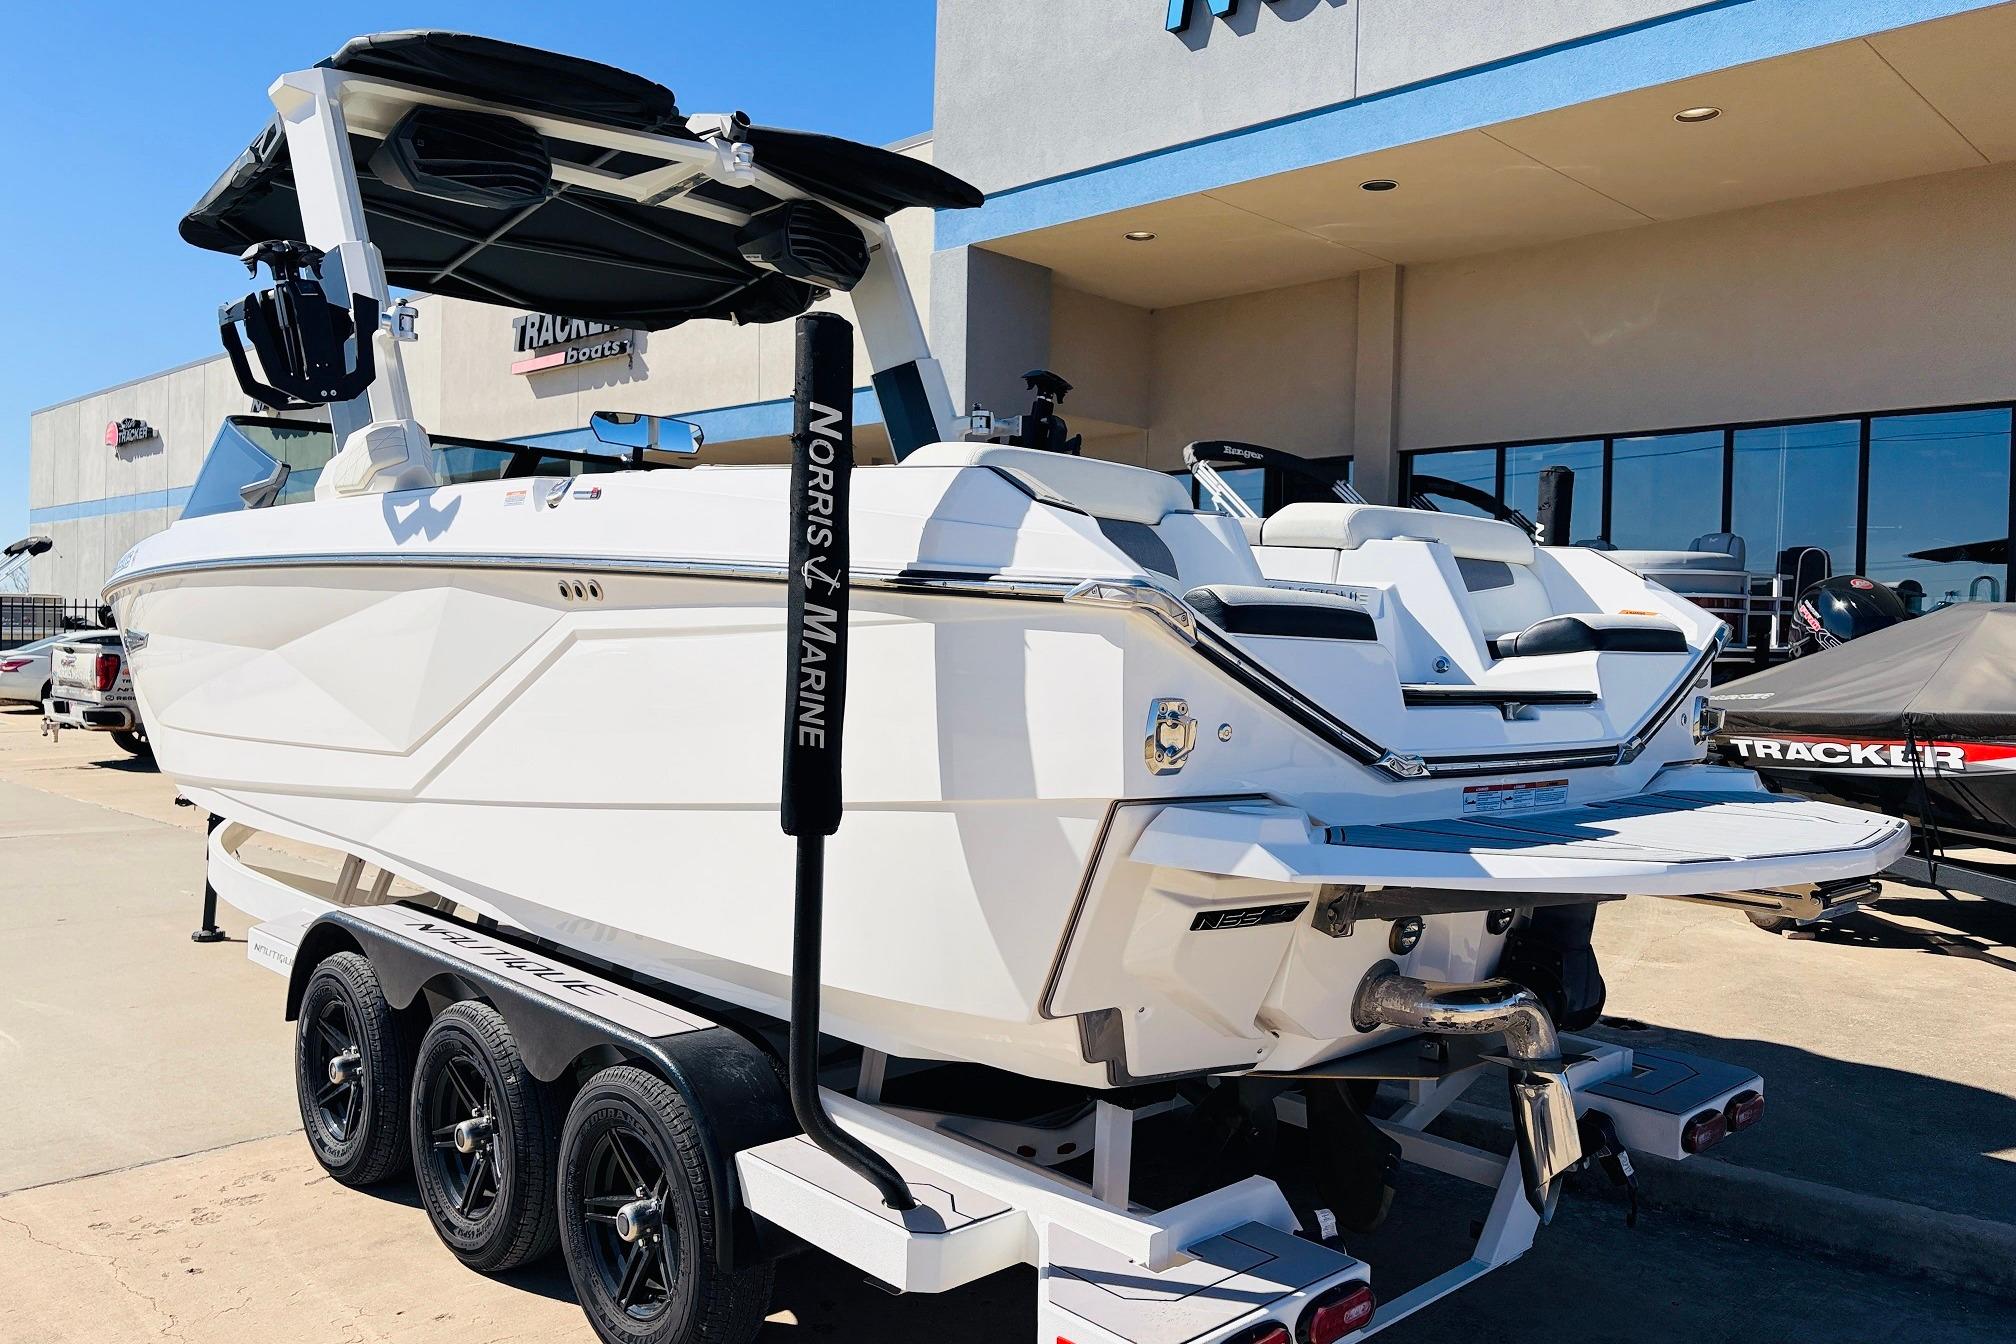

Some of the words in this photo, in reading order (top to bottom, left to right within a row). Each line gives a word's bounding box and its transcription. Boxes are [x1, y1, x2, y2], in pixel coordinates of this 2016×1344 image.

[512, 313, 621, 352] TRACK
[566, 341, 621, 364] boats
[119, 427, 149, 443] TRACKER
[1223, 445, 1264, 459] Ranger
[806, 401, 843, 548] NORRIS
[799, 602, 838, 749] MARINE
[1729, 738, 1965, 770] TRACKER
[254, 943, 294, 966] NAUTIQU
[404, 923, 619, 997] NAUTIQUE
